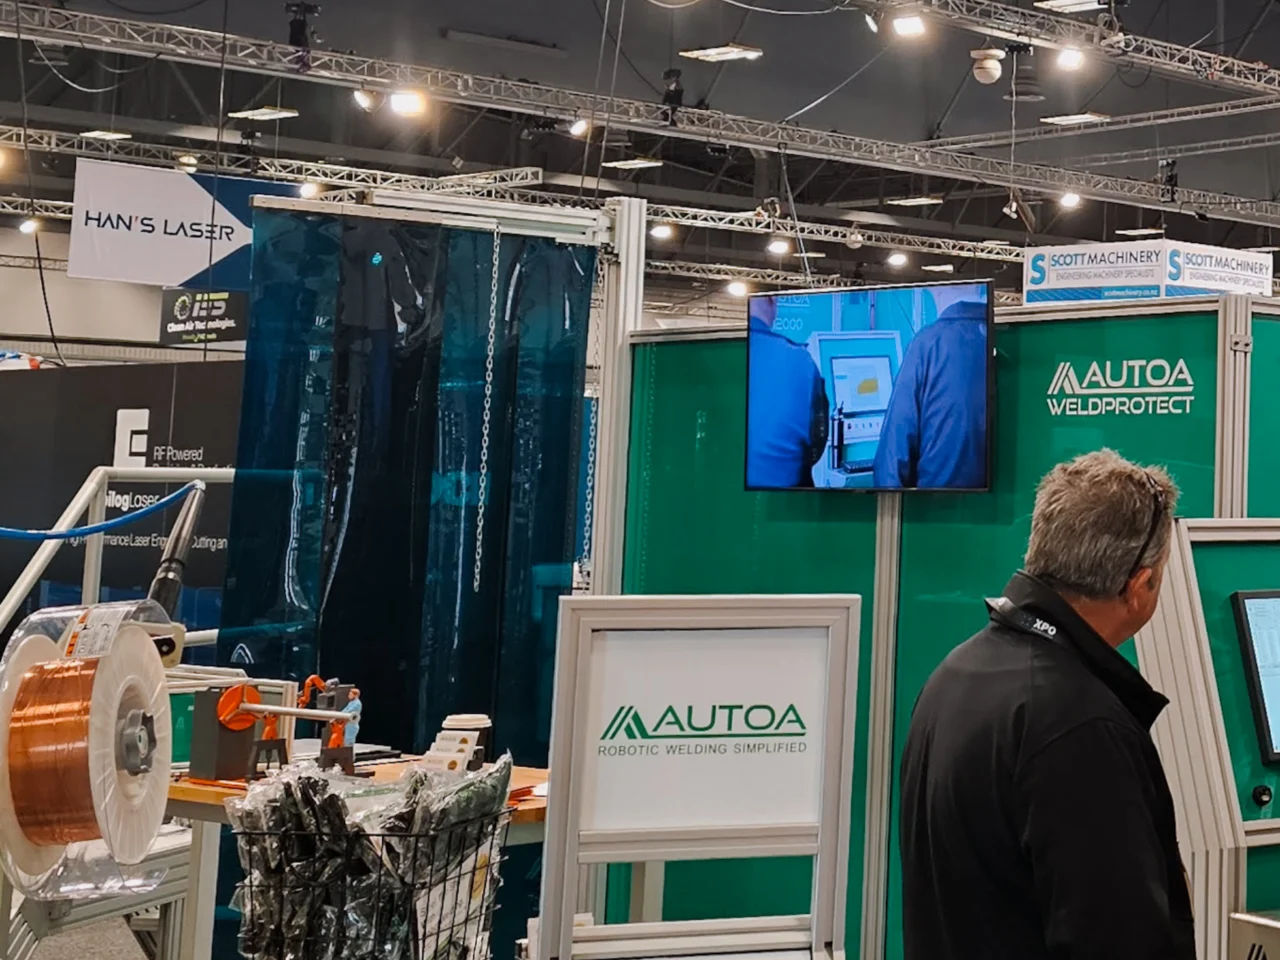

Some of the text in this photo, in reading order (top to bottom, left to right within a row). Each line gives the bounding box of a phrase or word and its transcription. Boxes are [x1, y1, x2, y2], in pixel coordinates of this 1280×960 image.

[84, 210, 235, 242] HAN'S LASER
[1081, 358, 1194, 388] AUTOA
[1046, 396, 1194, 416] WELDPROTECT
[167, 446, 203, 461] Powered
[1033, 618, 1057, 636] XPO
[653, 703, 807, 732] AUTOA
[598, 741, 807, 757] ROBOTIC WELDING SIMPLIFIED
